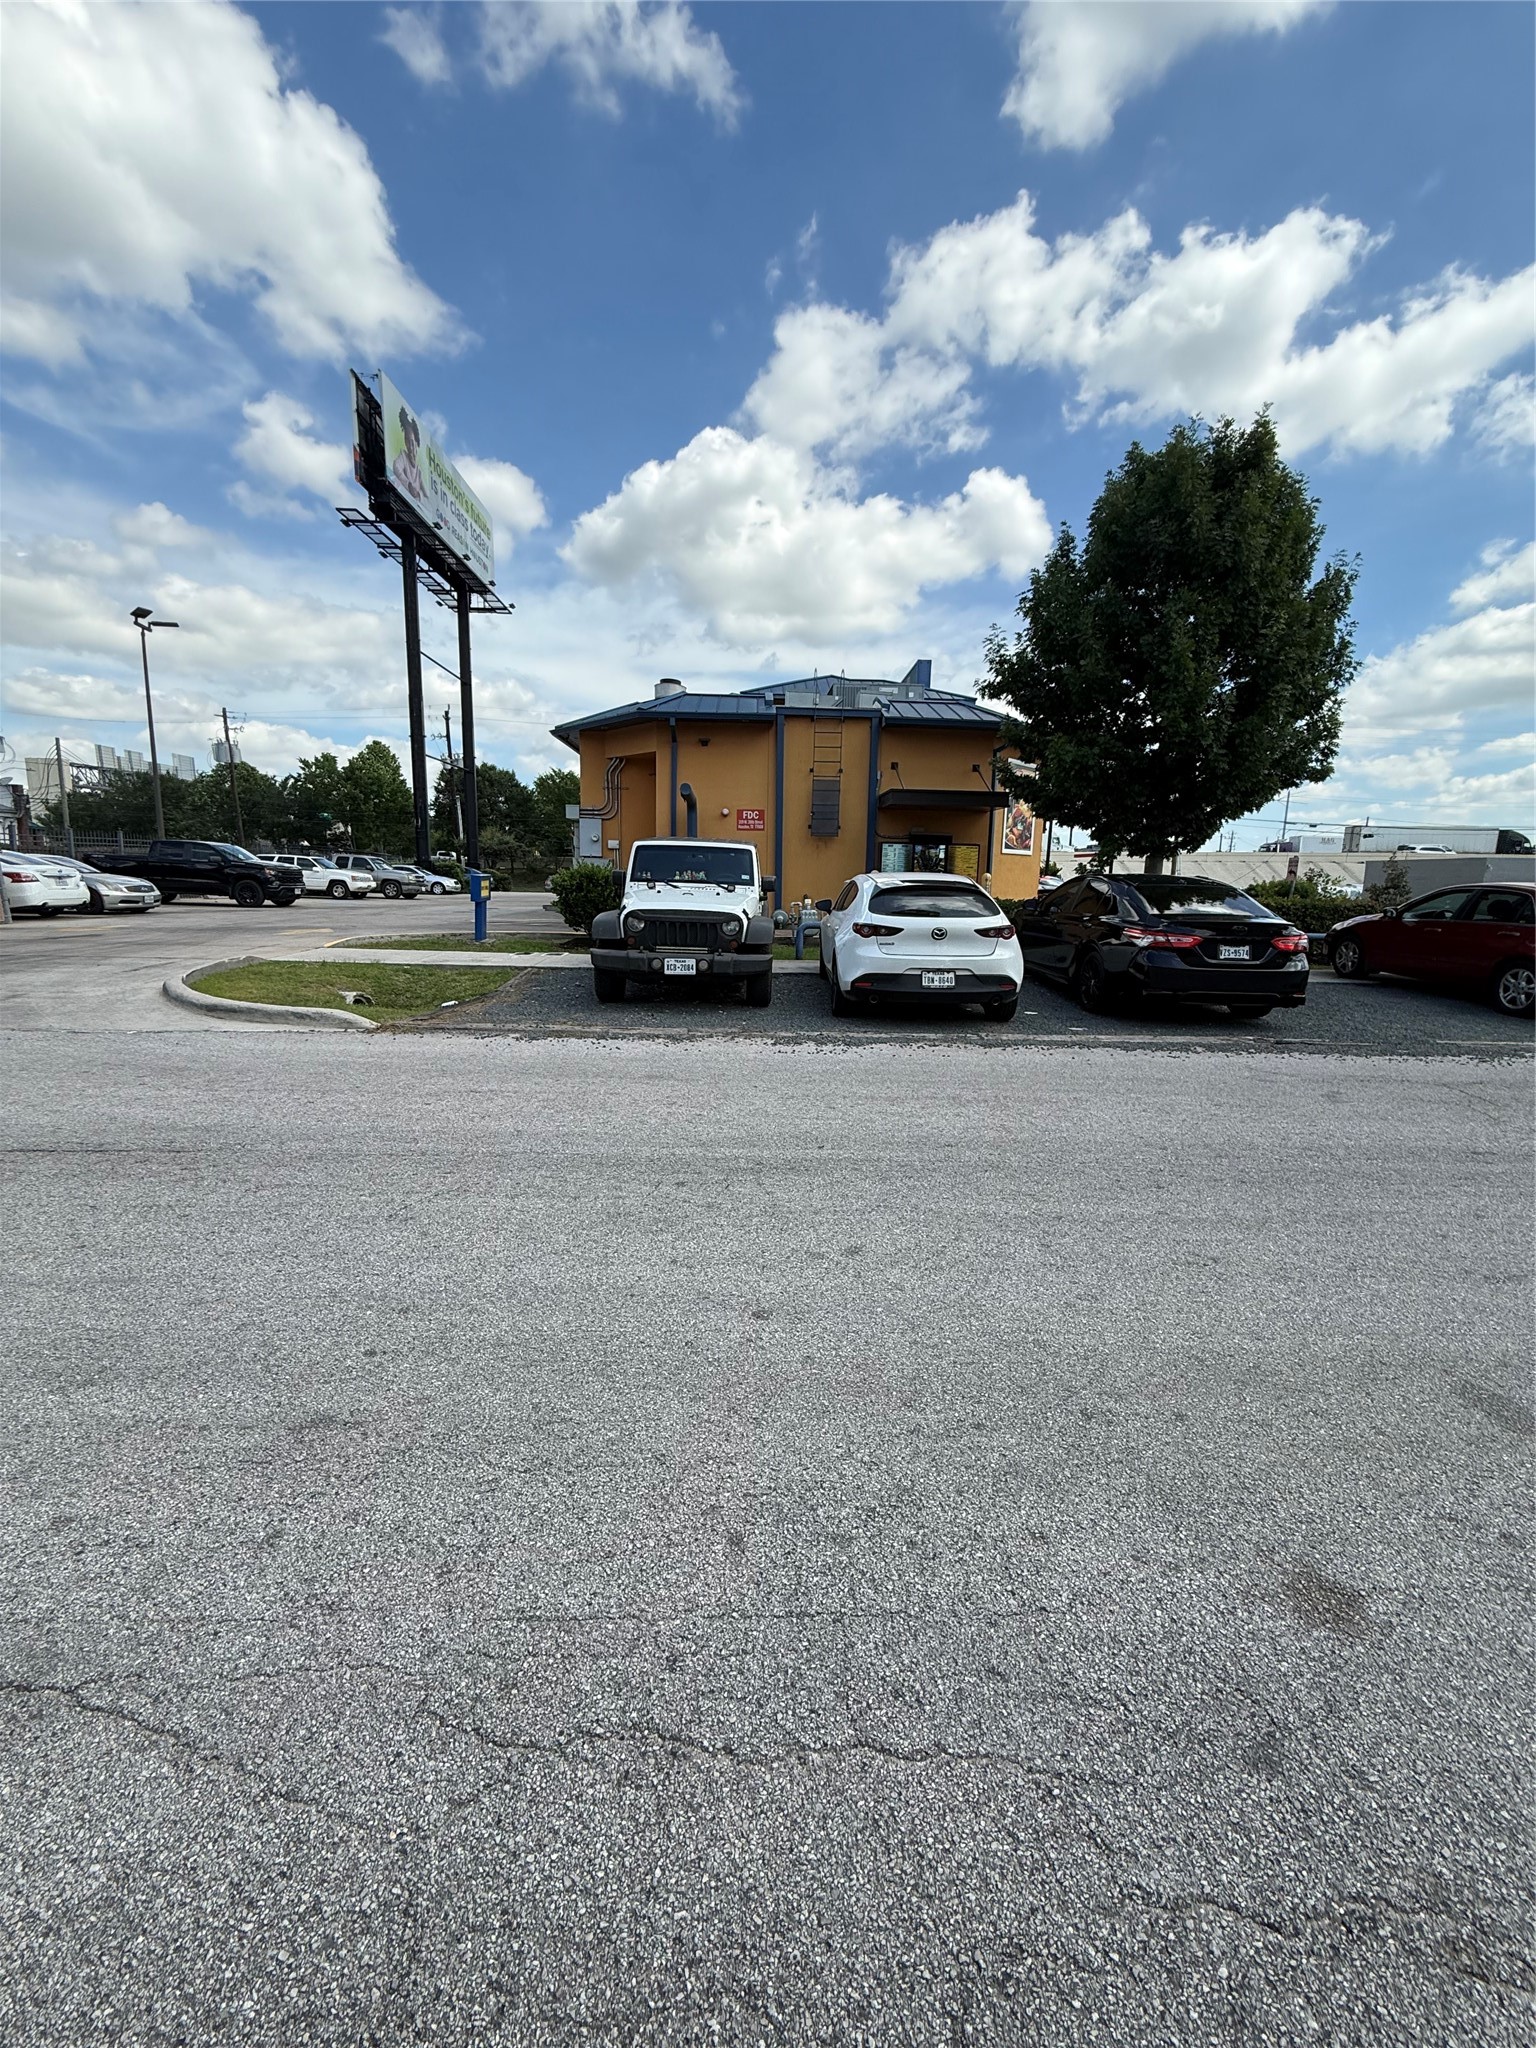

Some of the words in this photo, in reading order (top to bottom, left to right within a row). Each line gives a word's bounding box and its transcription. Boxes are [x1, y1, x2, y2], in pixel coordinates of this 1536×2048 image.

[428, 447, 469, 513] Houston's
[471, 503, 491, 540] future
[430, 470, 438, 495] is
[440, 481, 448, 507] in
[449, 500, 468, 531] class
[742, 810, 760, 819] FDC
